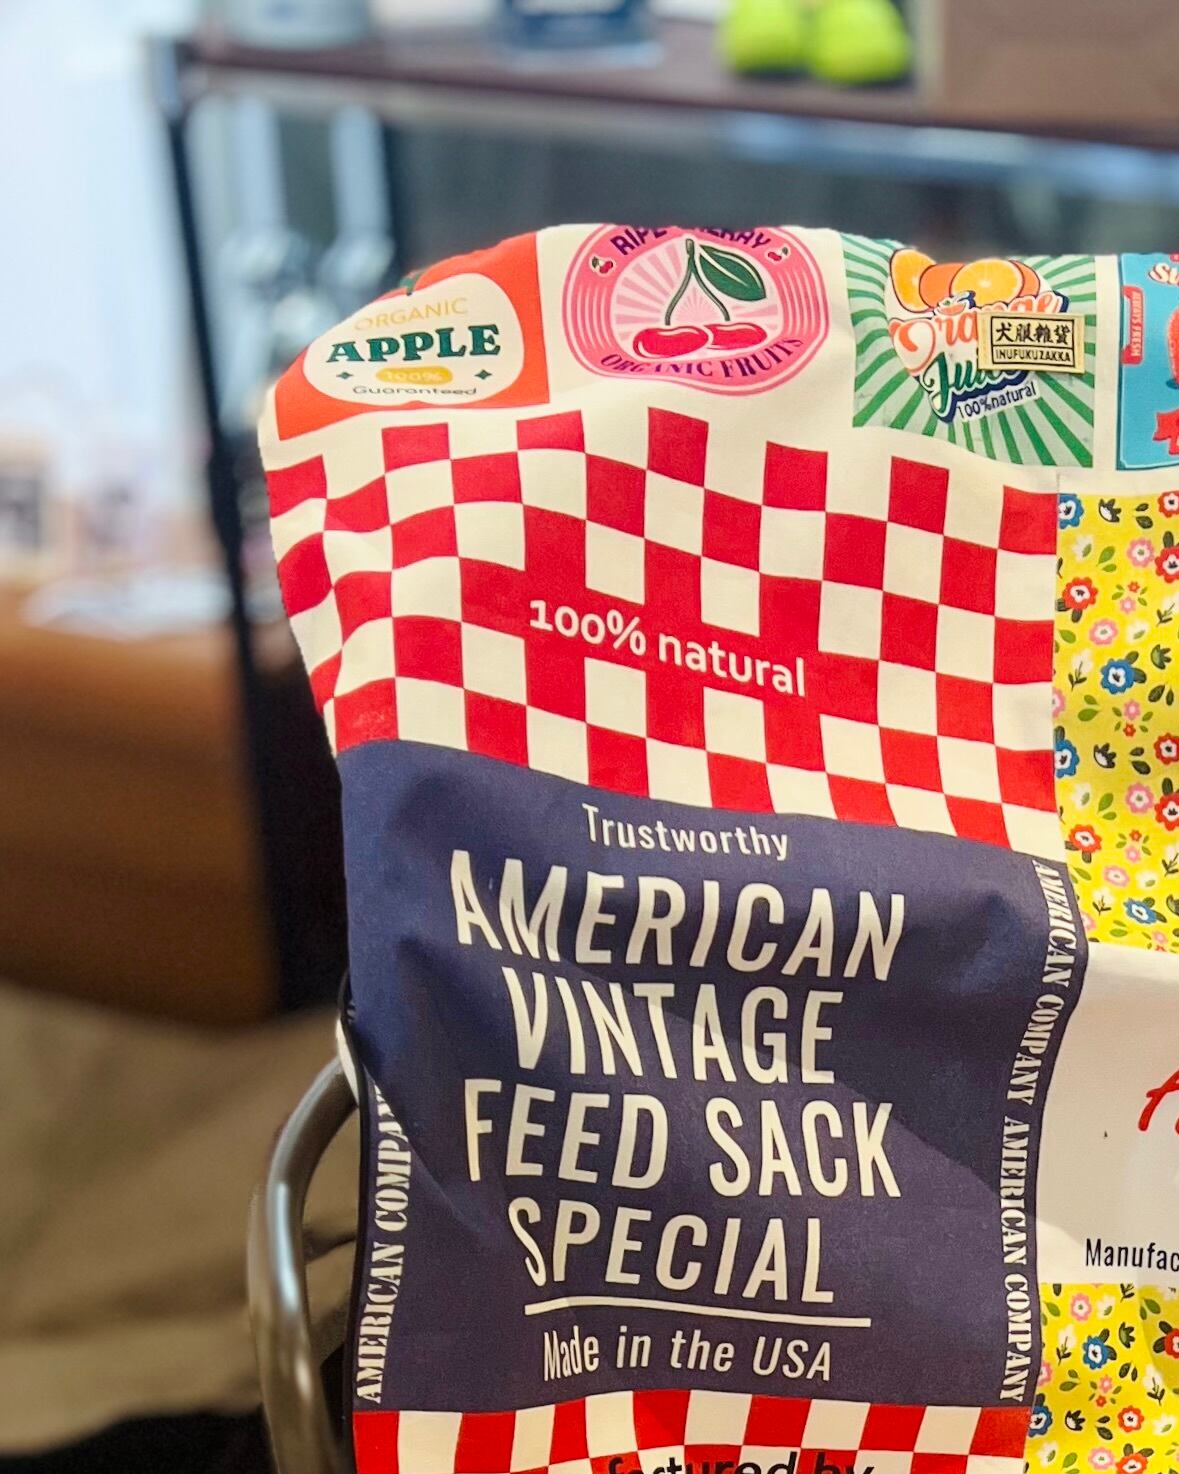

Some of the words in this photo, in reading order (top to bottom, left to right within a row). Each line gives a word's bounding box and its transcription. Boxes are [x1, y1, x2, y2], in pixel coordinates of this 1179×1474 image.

[326, 324, 502, 363] APPLE
[353, 298, 469, 332] ORGANIC
[600, 353, 713, 378] ORGANIC
[723, 339, 804, 378] FRUITS
[995, 349, 1071, 362] INUFUKUZAKKA
[353, 385, 477, 397] Guaranteed
[386, 367, 443, 382] 100%
[529, 600, 646, 655] 100%
[658, 632, 806, 697] natural
[581, 802, 788, 861] Trustworthy
[450, 849, 904, 981] AMERICAN
[1032, 859, 1077, 988] AMERICAN
[501, 966, 843, 1084] VINTAGE
[1006, 993, 1065, 1106] COMPANY
[374, 1084, 412, 1232] COMPA
[464, 1078, 668, 1189] FEED
[706, 1097, 901, 1198] SACK
[1000, 1116, 1030, 1265] AMERICAN
[508, 1196, 834, 1304] SPECIAL
[356, 1241, 405, 1404] AMERICAN
[543, 1325, 600, 1381] Made
[616, 1326, 651, 1368] in
[670, 1329, 735, 1372] the
[752, 1336, 831, 1381] USA
[1000, 1273, 1032, 1402] COMPANY
